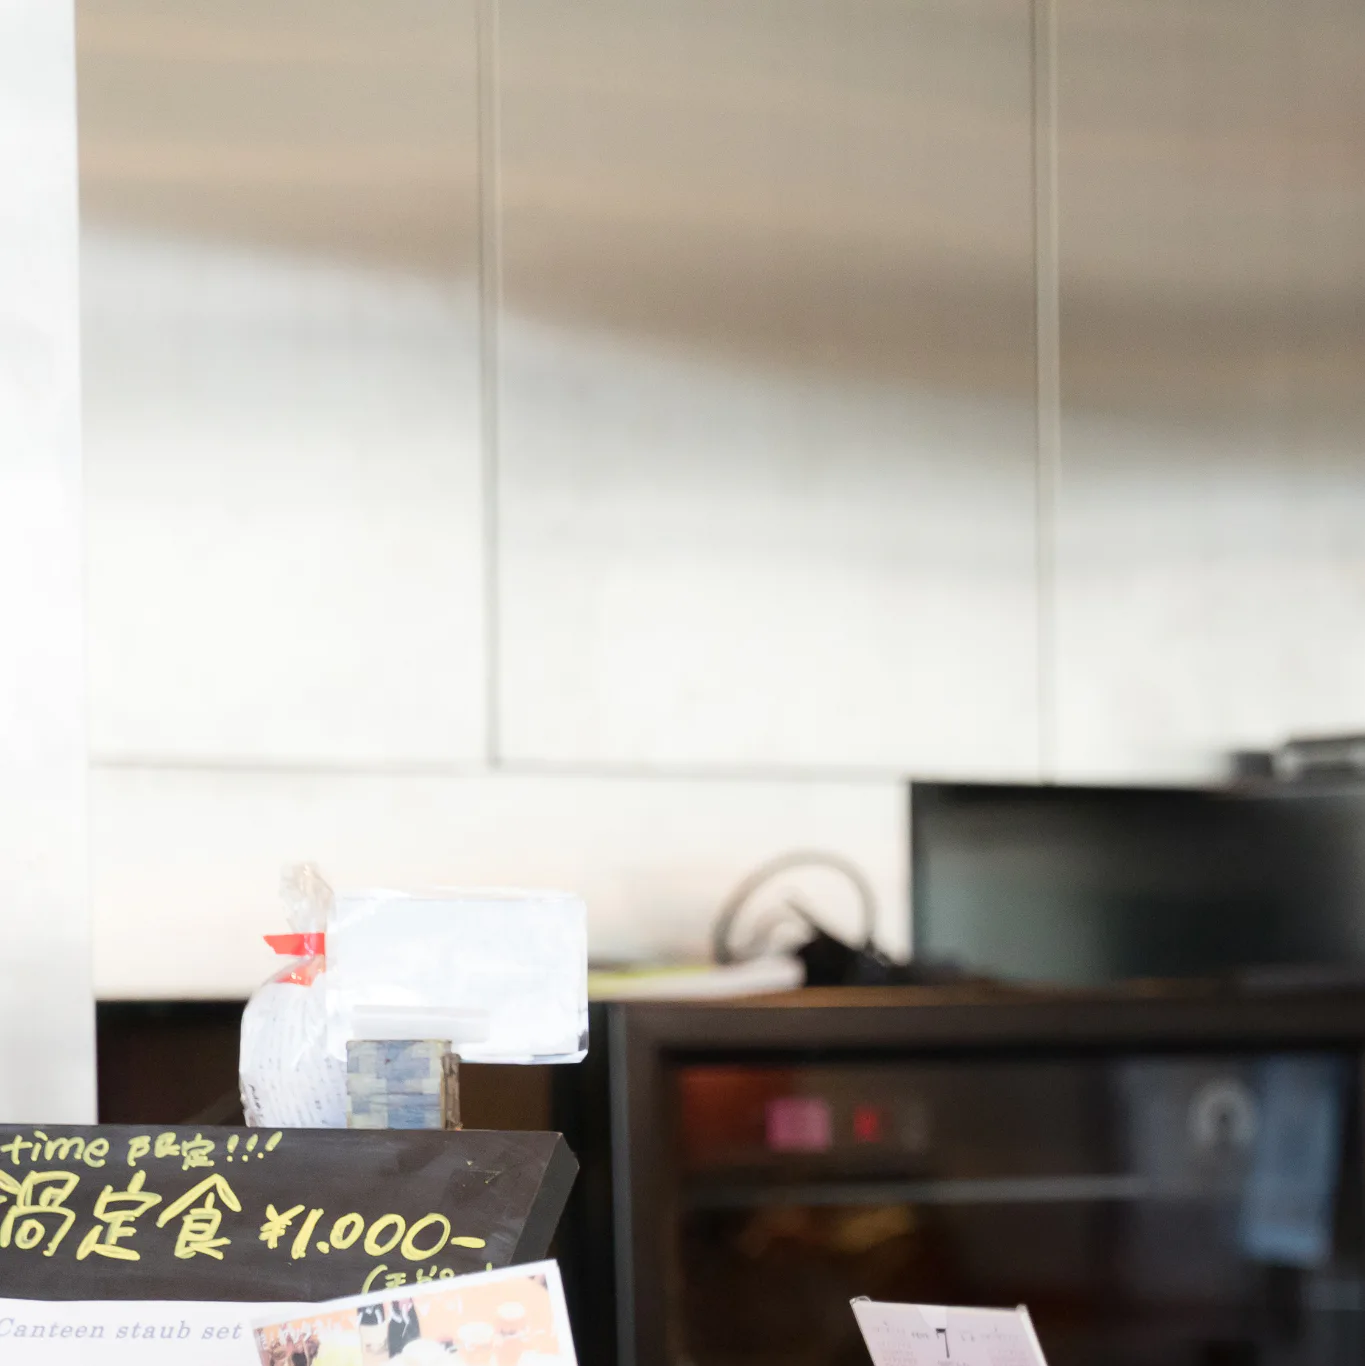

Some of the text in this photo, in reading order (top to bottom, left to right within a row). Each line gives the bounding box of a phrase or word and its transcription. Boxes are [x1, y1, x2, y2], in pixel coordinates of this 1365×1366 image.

[0, 1130, 109, 1168] time
[116, 1320, 191, 1341] staub
[201, 1322, 242, 1341] set
